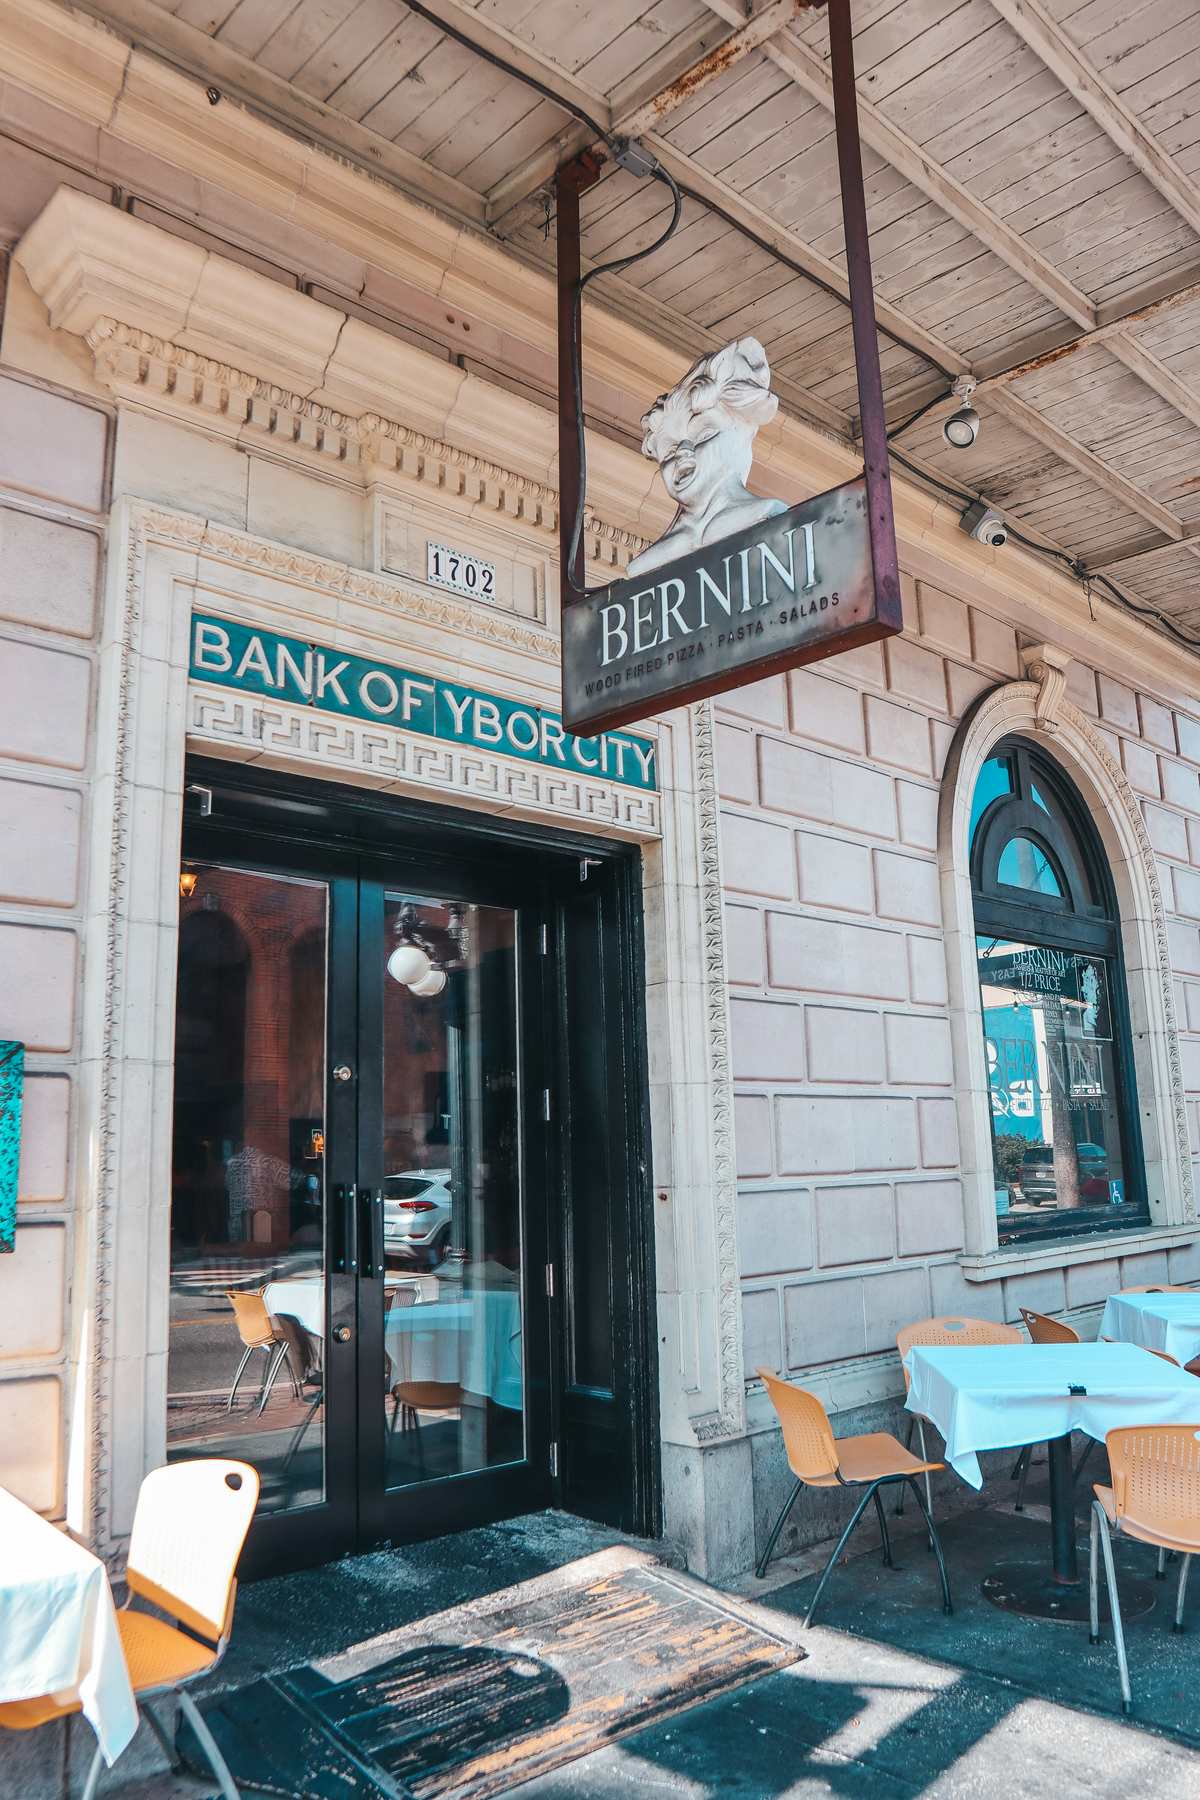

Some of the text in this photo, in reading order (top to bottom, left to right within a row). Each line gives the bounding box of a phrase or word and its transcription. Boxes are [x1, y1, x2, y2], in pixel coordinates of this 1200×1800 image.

[431, 550, 494, 595] 1702
[600, 519, 819, 668] BERNINI
[585, 592, 840, 697] WOOD FIRED PIZZA PASTA SALADS
[194, 621, 655, 783] BANK OF YBOR CITY
[1034, 974, 1061, 992] PRICE
